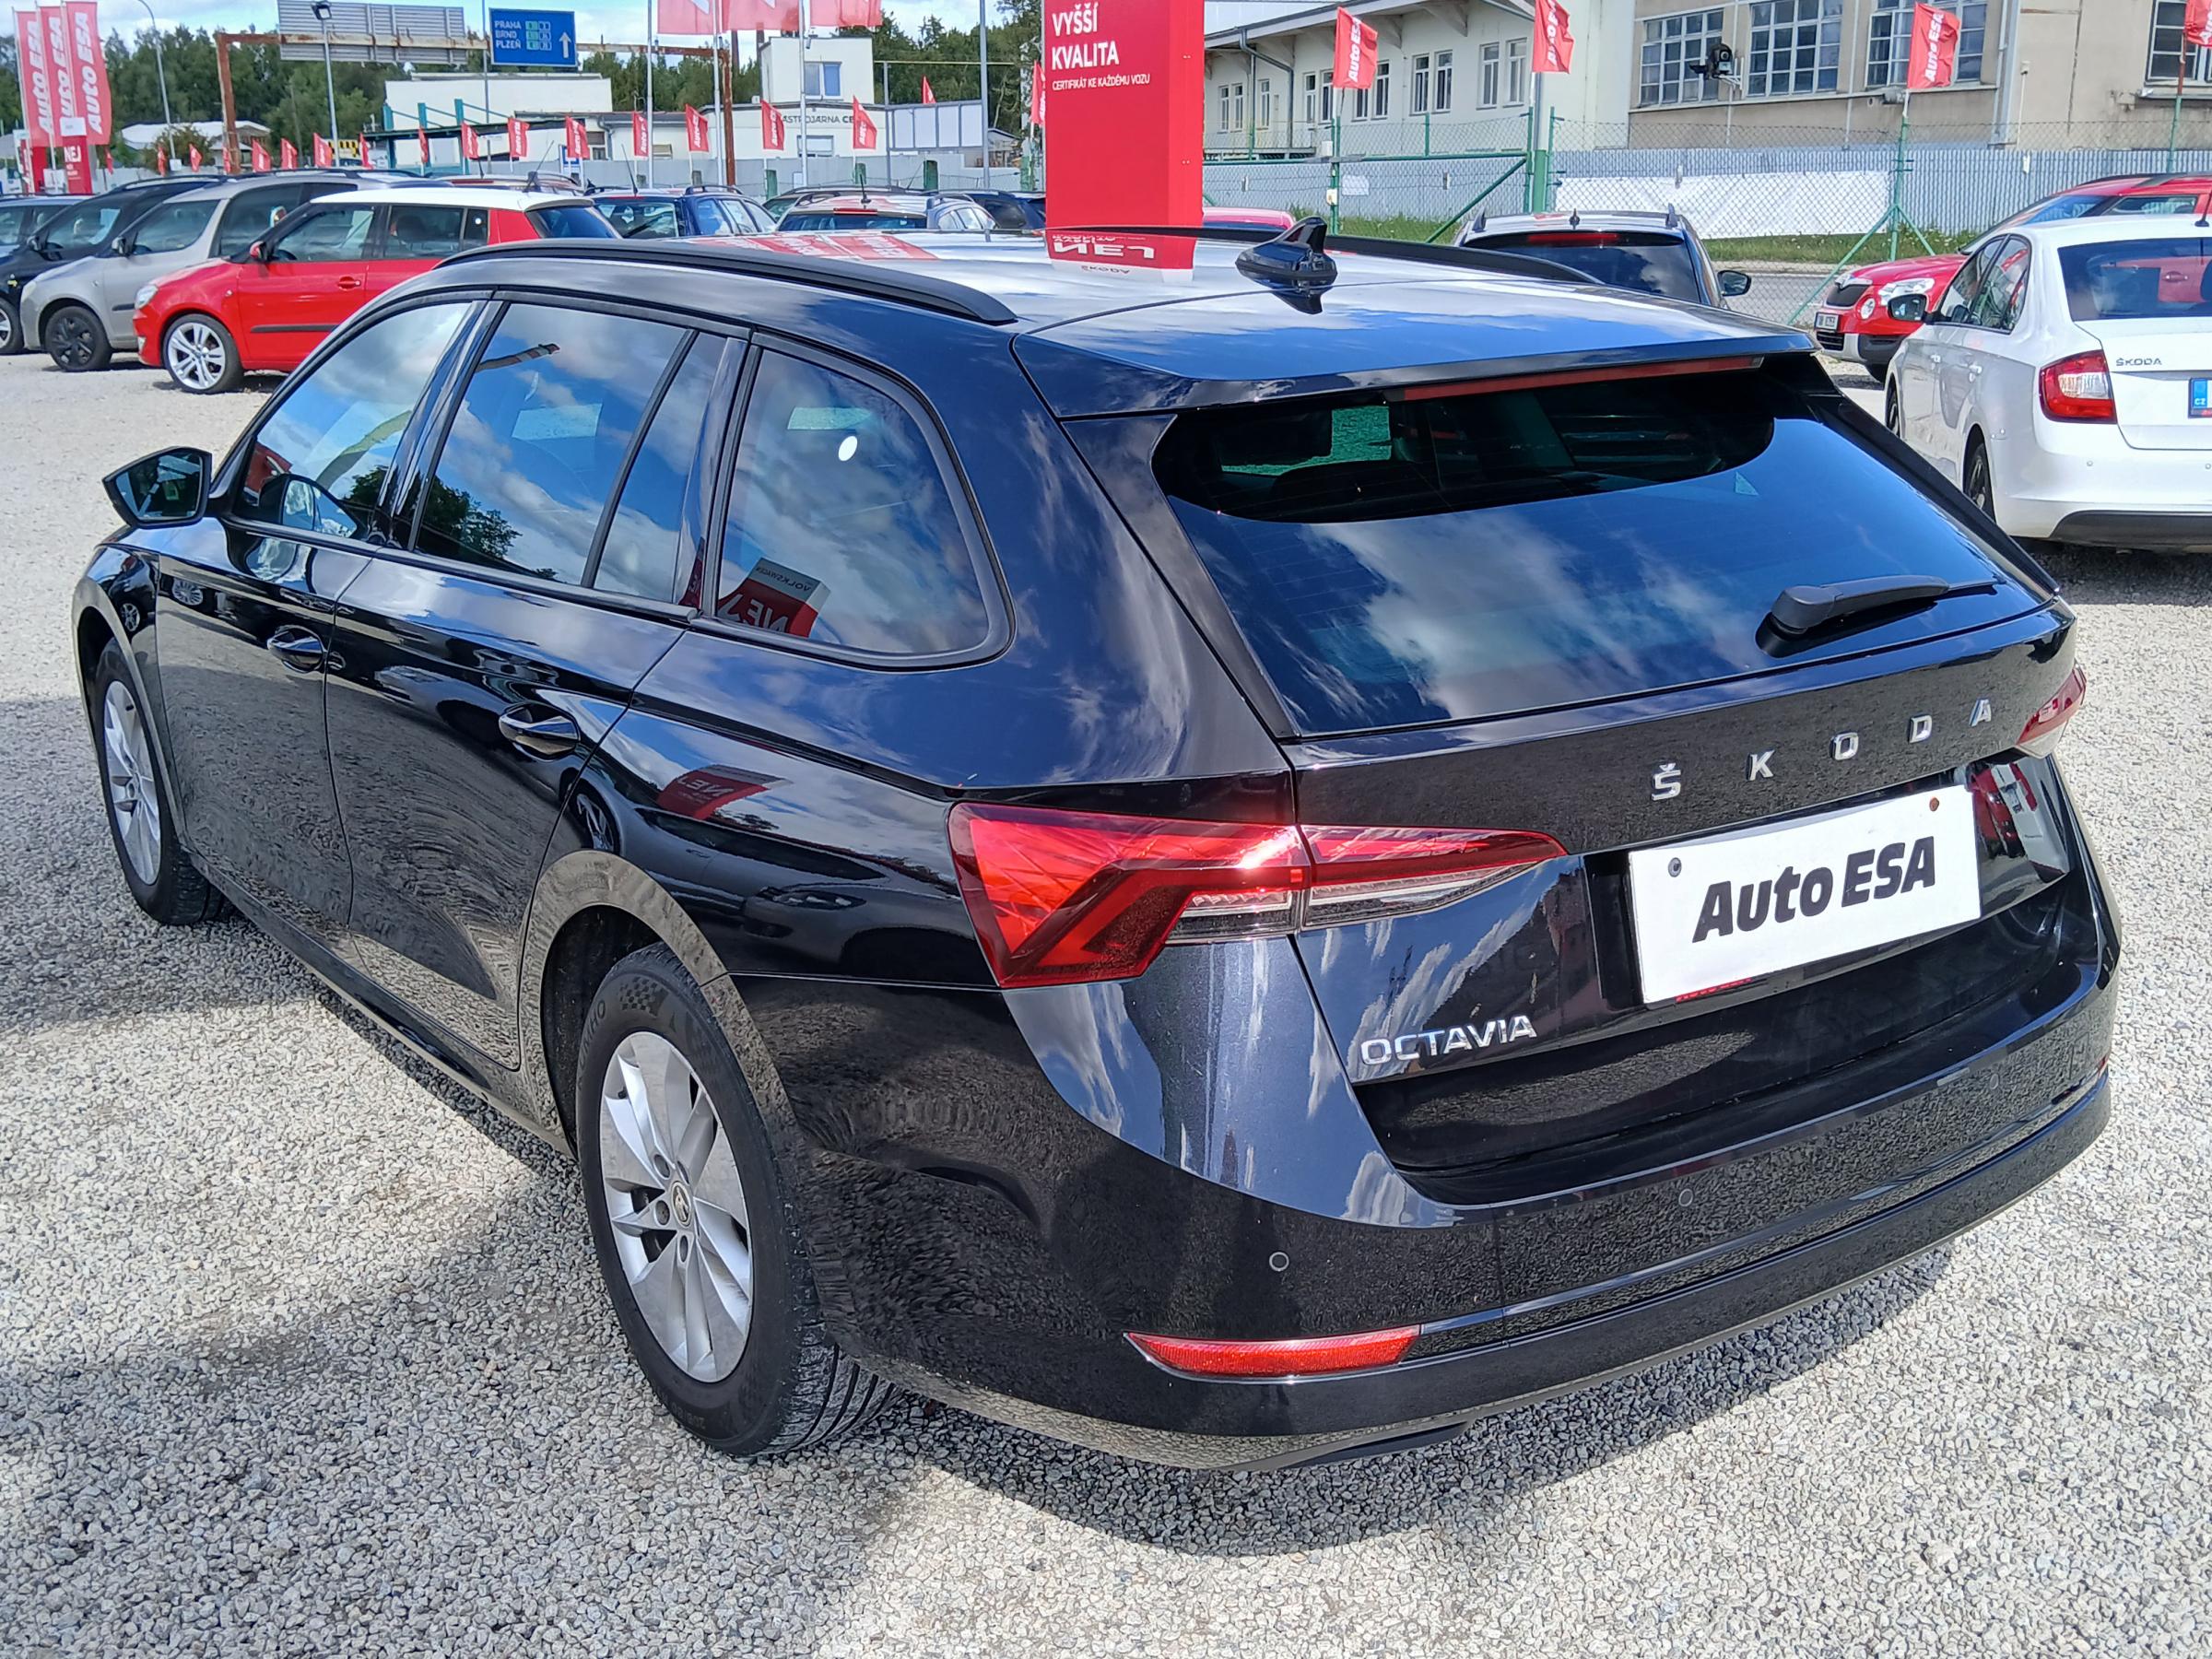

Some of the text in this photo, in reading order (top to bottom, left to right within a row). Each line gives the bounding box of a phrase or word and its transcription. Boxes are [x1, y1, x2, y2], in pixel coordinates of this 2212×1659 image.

[494, 20, 522, 29] PRAHA
[1052, 1, 1099, 37] VYŠŠÍ
[496, 39, 521, 49] PLZEŇ
[1051, 41, 1120, 70] KVALITA
[1347, 43, 1360, 83] Auto
[1924, 13, 1944, 82] Auto ESA
[75, 12, 103, 135] Auto ESA
[1052, 73, 1150, 91] CERTIFIKÁT KE KAŽDÉMU VOZU
[2115, 358, 2162, 367] ŠKODA
[1650, 698, 1992, 802] ŠKODA
[1692, 836, 1936, 943] Auto ESA
[1360, 1015, 1537, 1065] OCTAVIA
